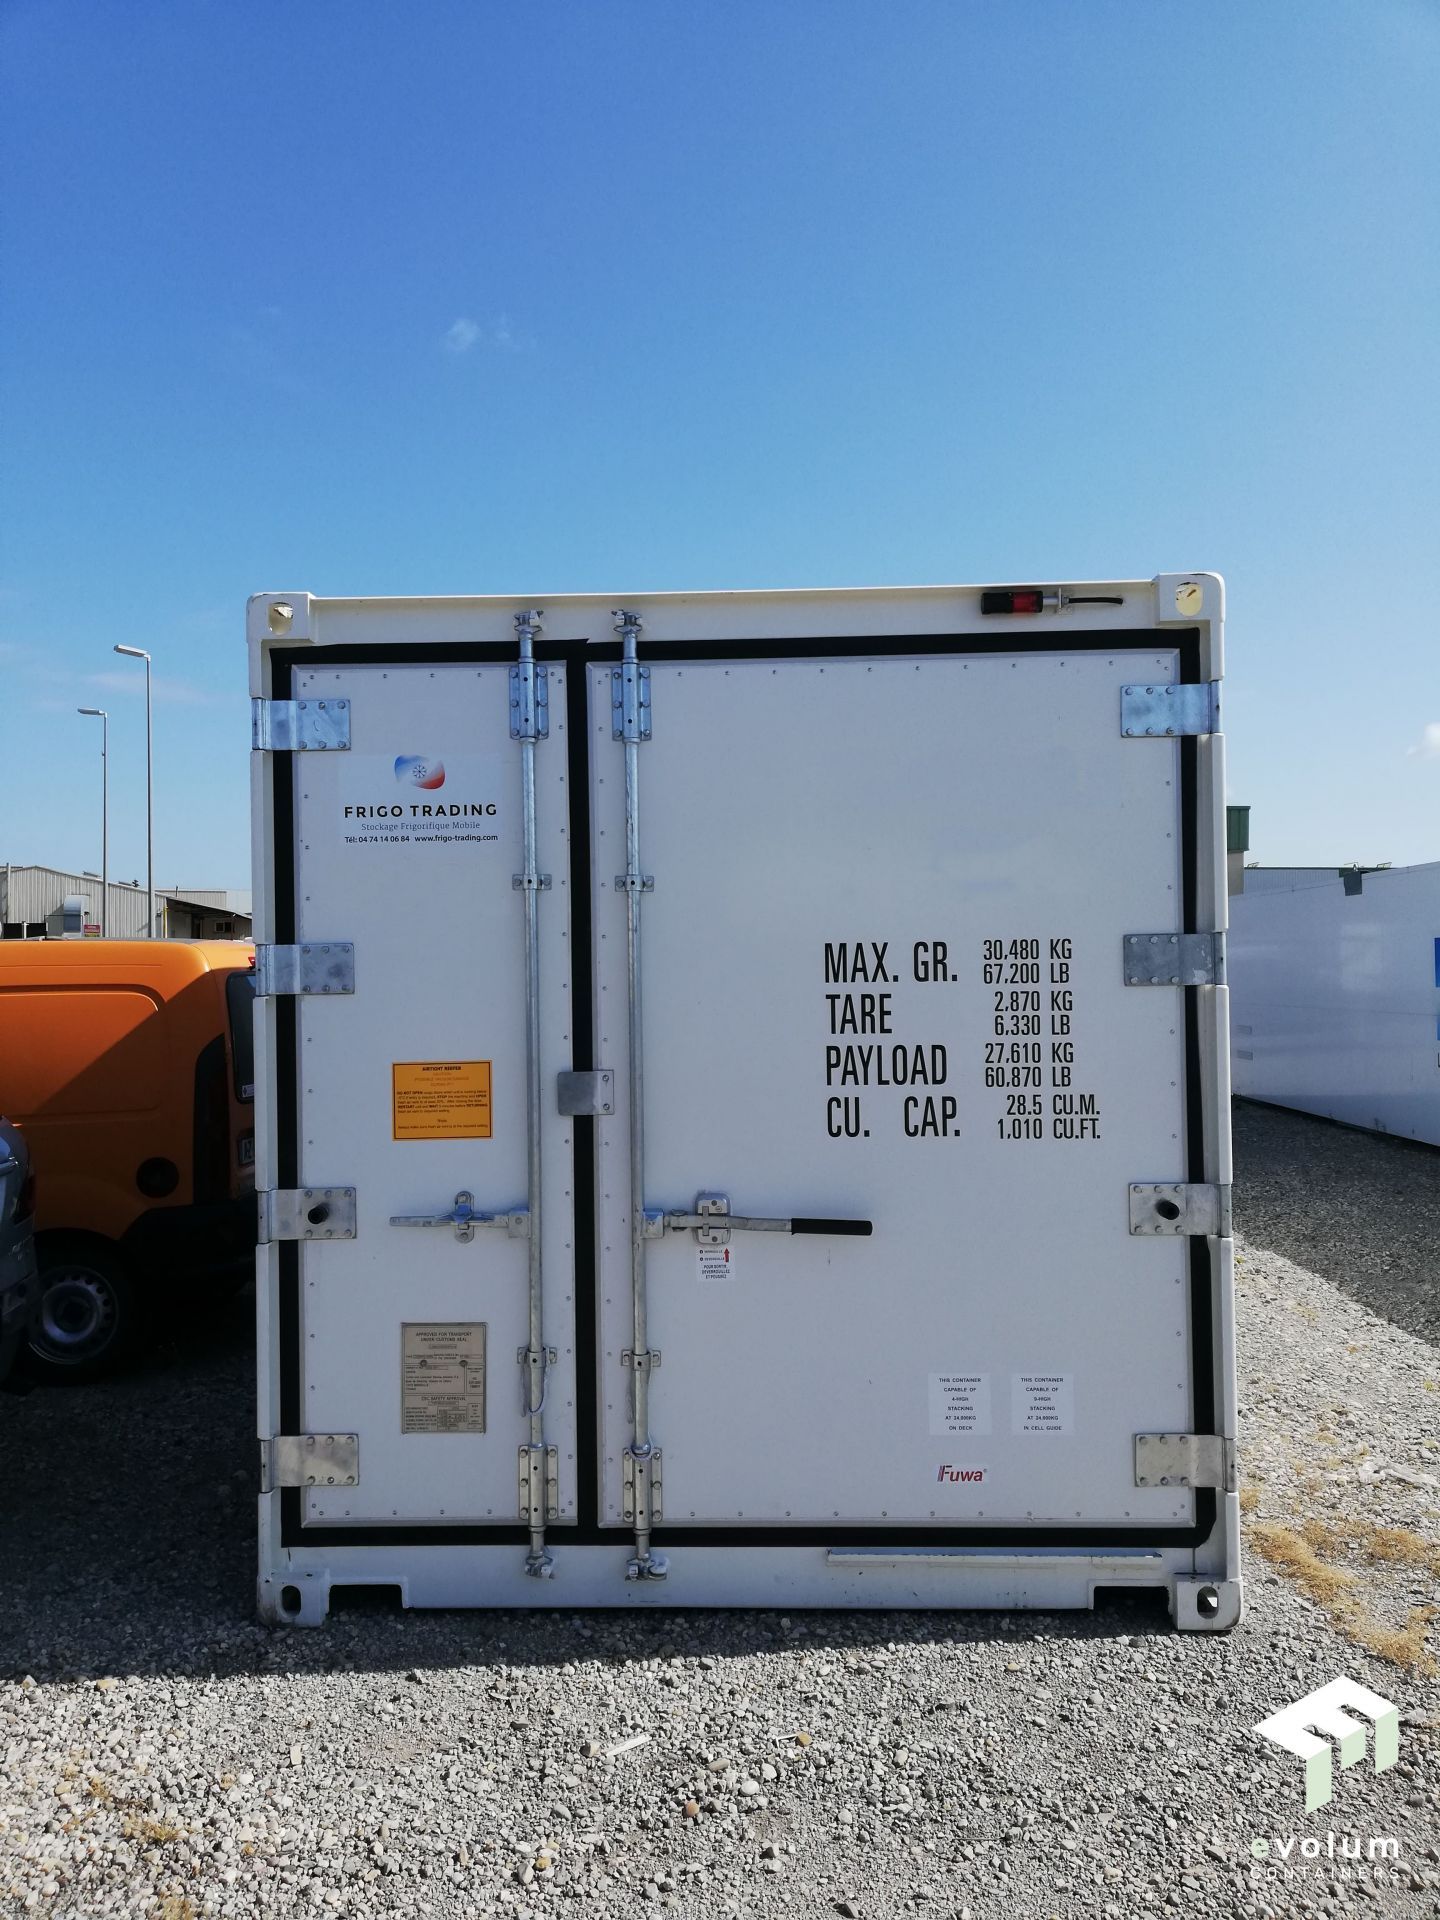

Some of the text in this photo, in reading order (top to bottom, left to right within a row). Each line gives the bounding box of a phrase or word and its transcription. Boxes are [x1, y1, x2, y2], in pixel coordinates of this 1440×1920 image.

[344, 803, 497, 818] FRIGO TRADING
[361, 821, 480, 832] Stockage Frigorifique Mobile
[414, 834, 498, 843] www.frigo-trading.com
[1050, 938, 1072, 960] KG
[824, 941, 958, 983] MAX. GR.
[1050, 962, 1070, 984] LB
[1051, 990, 1073, 1012] KG
[826, 993, 892, 1035] TARE
[1051, 1014, 1070, 1036] LB
[1052, 1042, 1074, 1064] KG
[826, 1044, 947, 1086] PAYLOAD
[1052, 1066, 1071, 1088] LB
[1006, 1094, 1101, 1116] 28.5 CU.M.
[827, 1096, 961, 1137] CU. CAP.
[1053, 1118, 1101, 1140] CU.FT.
[937, 1465, 983, 1482] Fuwa
